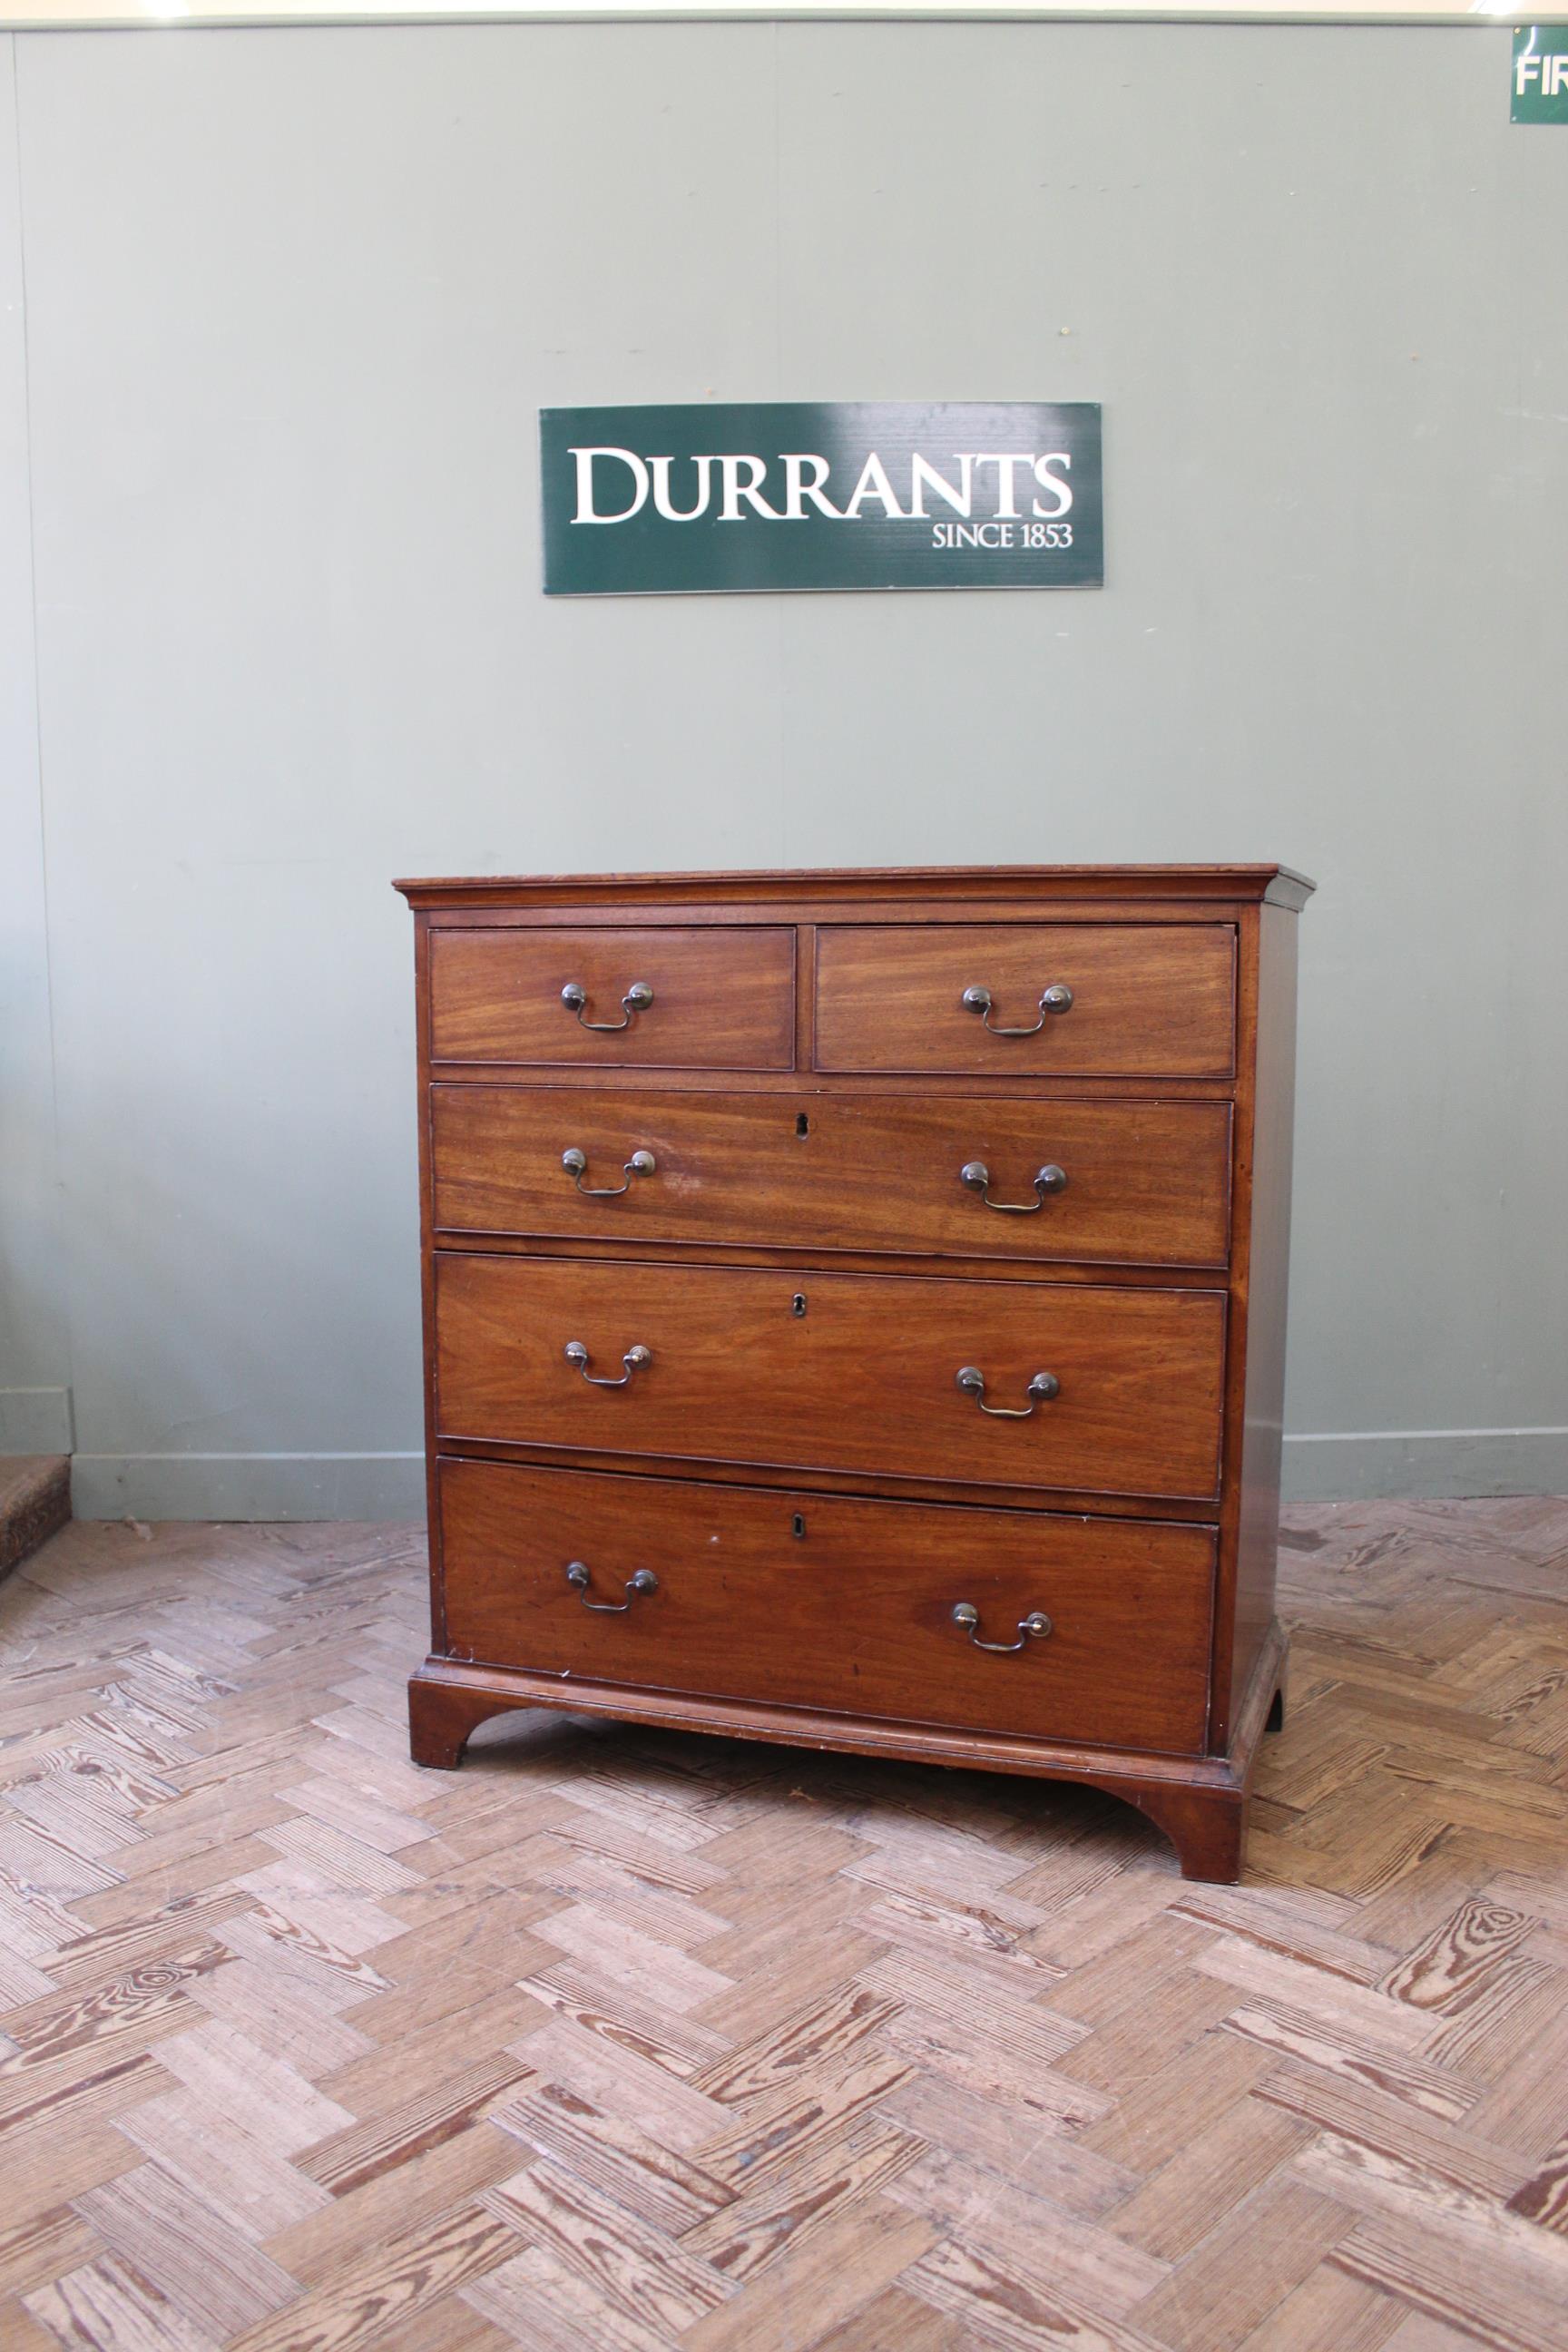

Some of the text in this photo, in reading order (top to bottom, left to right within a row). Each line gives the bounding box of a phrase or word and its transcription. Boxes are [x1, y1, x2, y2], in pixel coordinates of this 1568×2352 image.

[566, 446, 1073, 524] DURRANTS
[931, 523, 1074, 549] SINCE 1853
